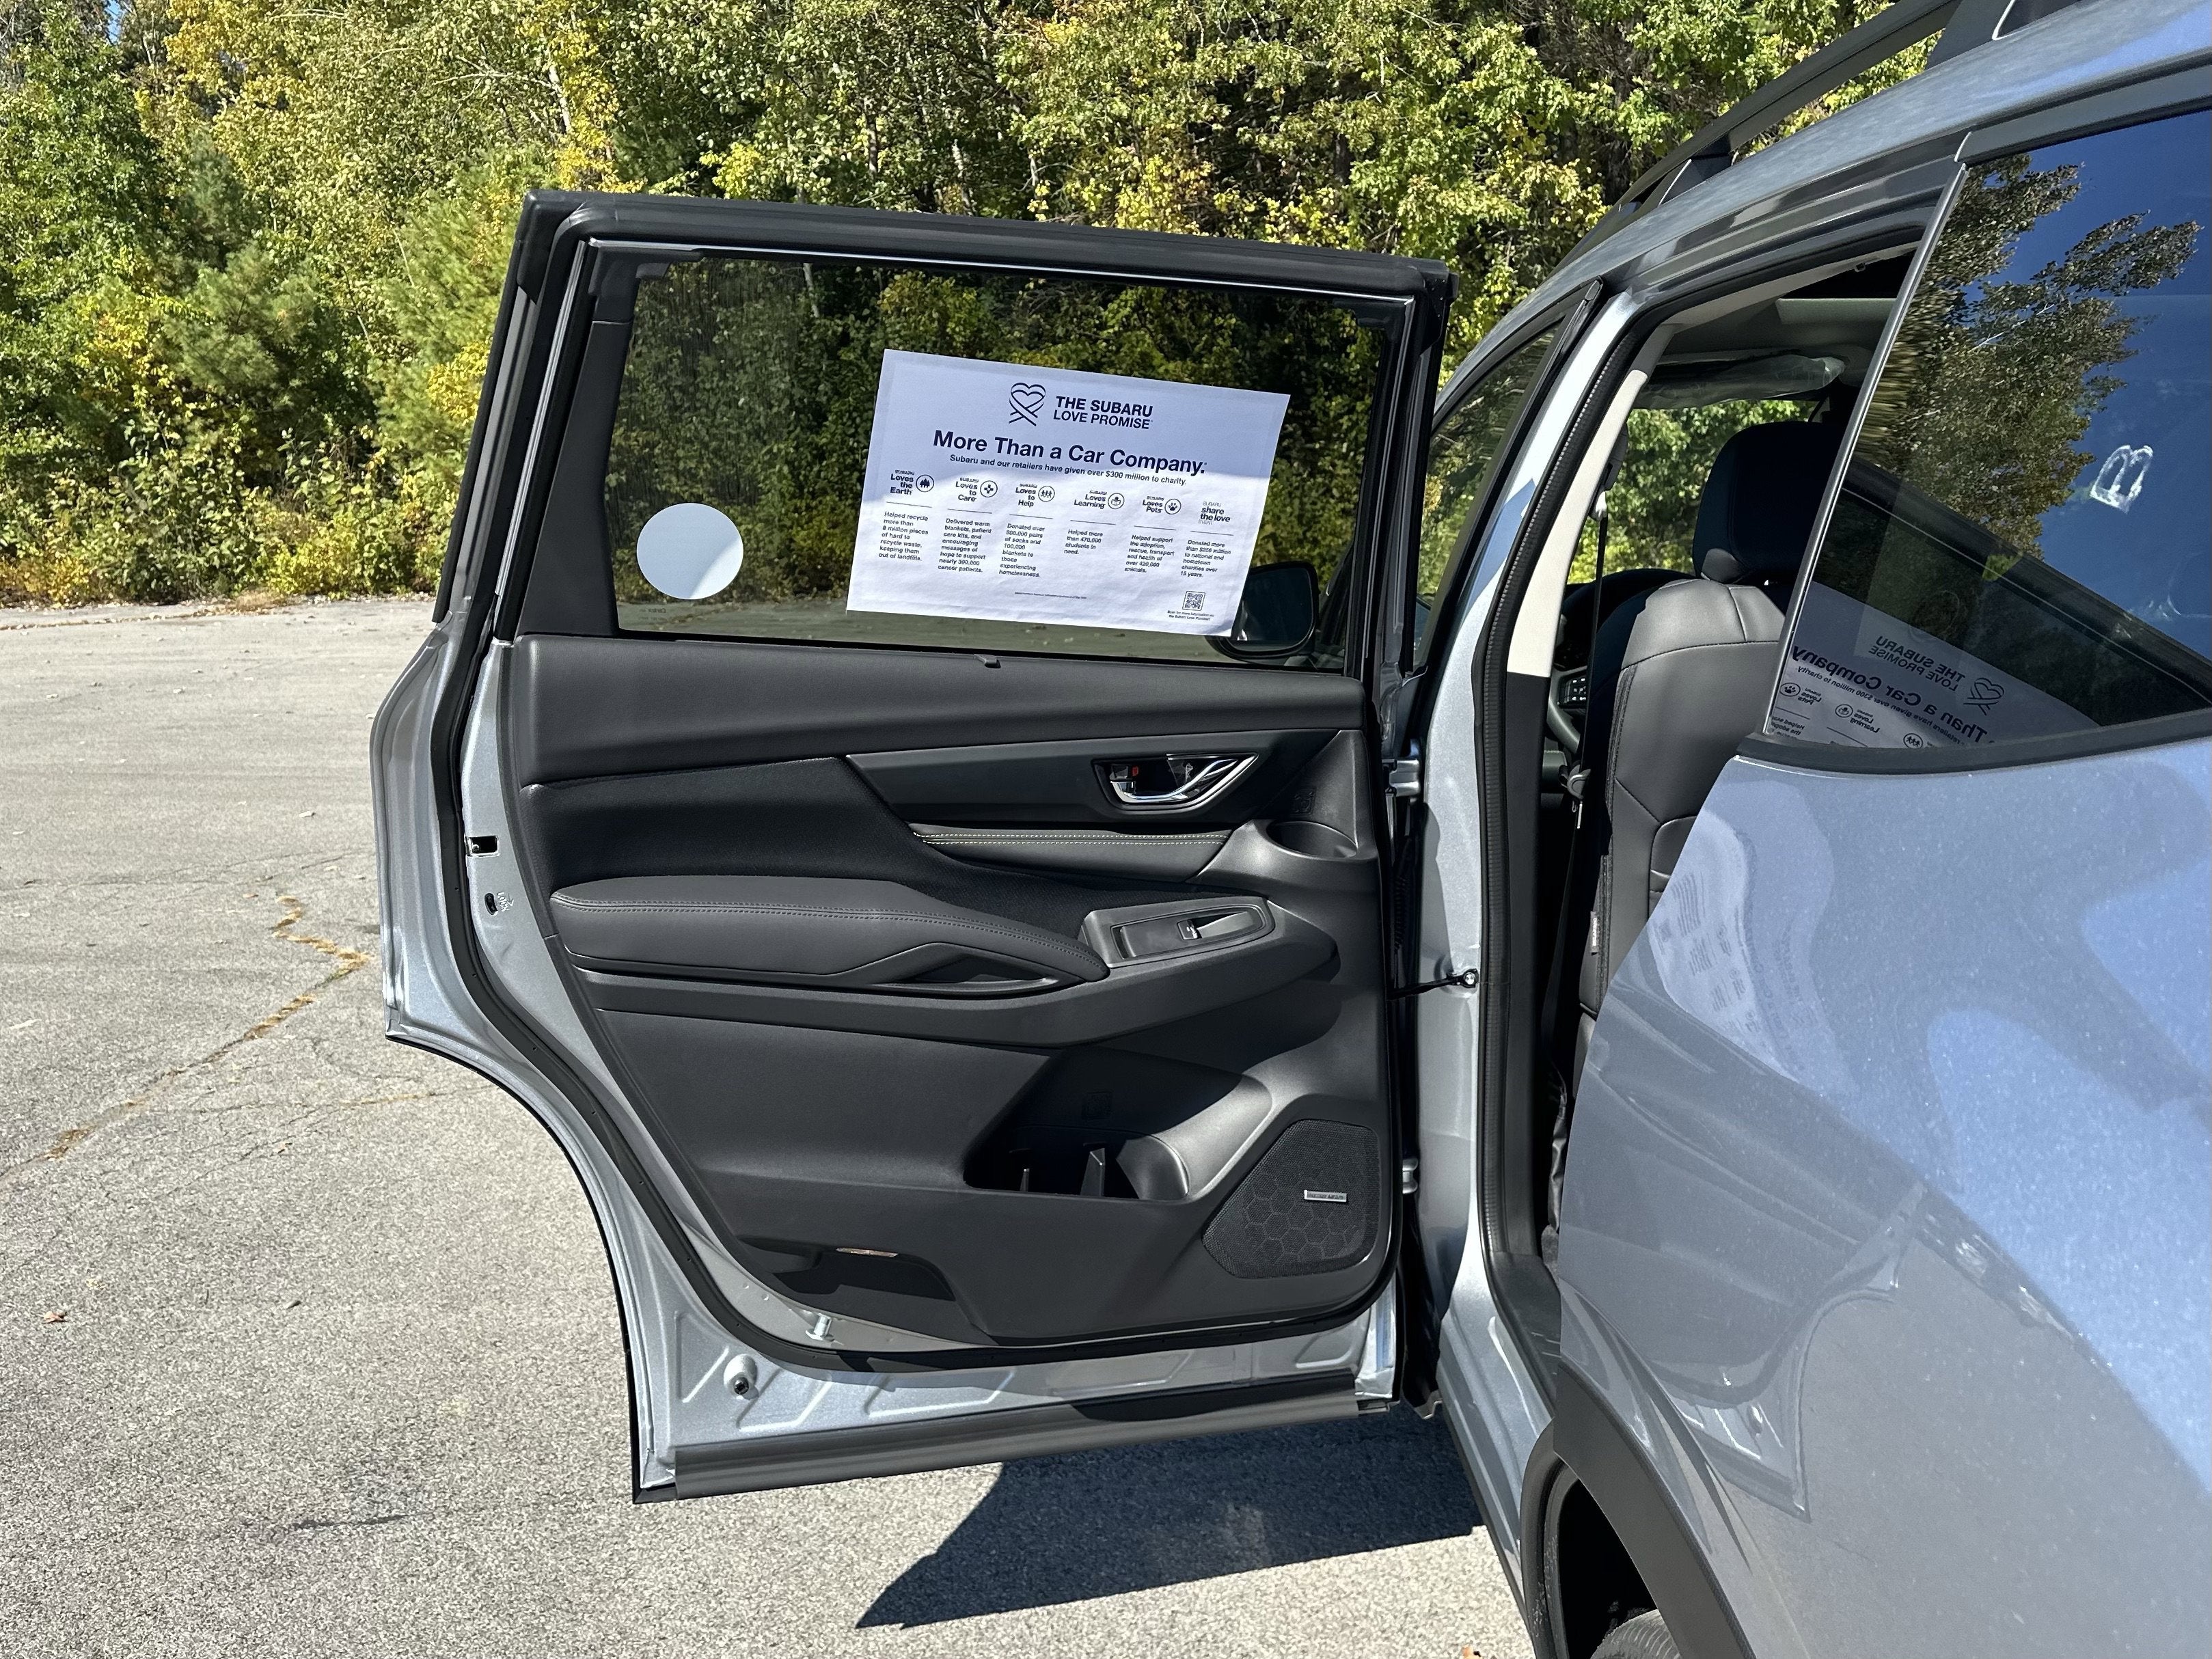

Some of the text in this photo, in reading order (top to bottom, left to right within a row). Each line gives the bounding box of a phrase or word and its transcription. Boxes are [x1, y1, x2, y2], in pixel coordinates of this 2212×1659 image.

[1056, 396, 1153, 417] THE SUBARU
[1053, 410, 1088, 423] LOVE
[933, 430, 987, 452] More
[995, 437, 1043, 457] Than
[1050, 447, 1062, 459] a
[1069, 445, 1104, 463] Car
[950, 454, 978, 464] Subaru
[1012, 462, 1042, 470] retailers
[1045, 464, 1063, 472] have
[1065, 467, 1085, 475] given
[1106, 470, 1123, 478] $300
[890, 474, 914, 482] Loves
[956, 481, 977, 489] Loves
[890, 487, 912, 495] Earth
[1018, 499, 1034, 508] Help
[1074, 499, 1106, 509] Learning
[1201, 506, 1224, 515] share
[1000, 563, 1036, 571] experiencing
